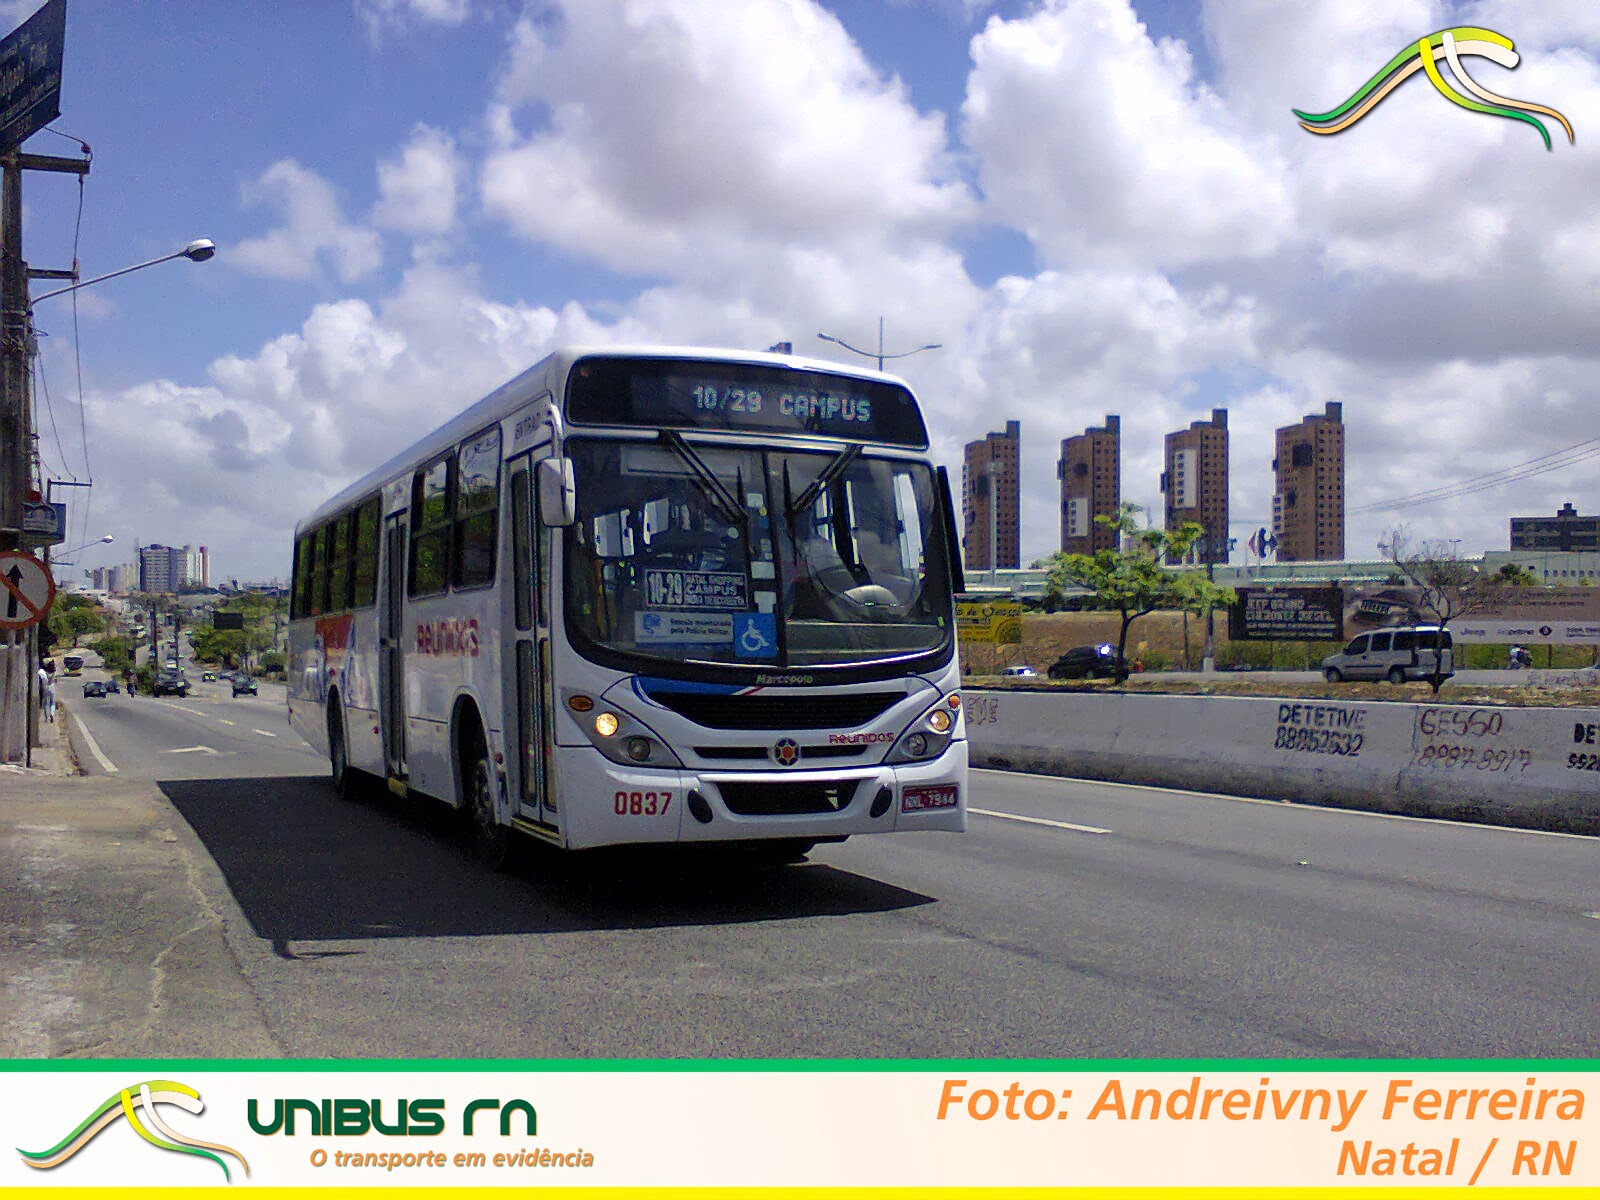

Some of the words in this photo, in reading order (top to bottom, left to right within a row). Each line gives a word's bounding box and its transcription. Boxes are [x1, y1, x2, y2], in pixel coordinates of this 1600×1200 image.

[780, 394, 871, 422] CAMPUS
[685, 584, 737, 596] CAMPUS
[756, 674, 814, 684] Marcopolo
[1278, 703, 1368, 730] DETETIVE
[1420, 708, 1503, 738] GESSO
[1573, 722, 1600, 744] DE
[614, 791, 673, 816] 0837
